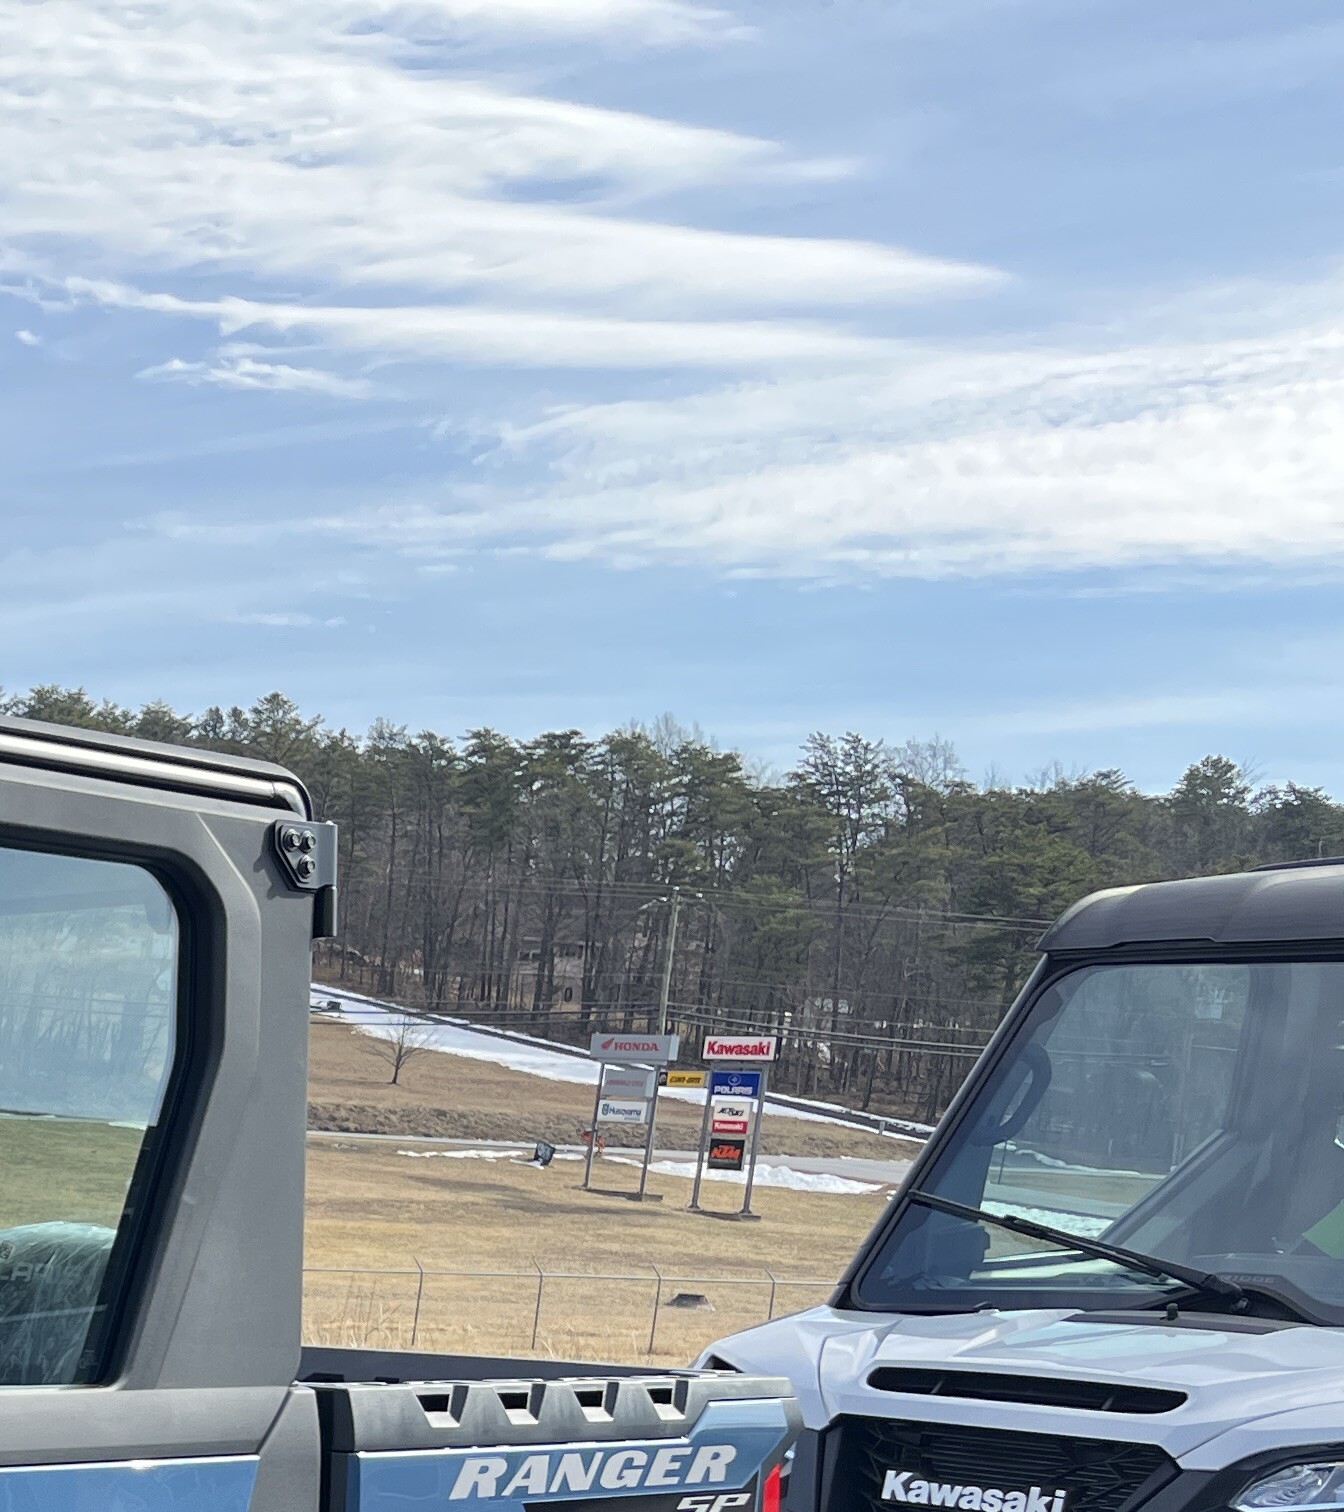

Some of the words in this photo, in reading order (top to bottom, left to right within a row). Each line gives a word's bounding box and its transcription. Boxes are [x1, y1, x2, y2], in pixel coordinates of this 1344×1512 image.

[614, 1042, 659, 1051] HONDA
[706, 1041, 771, 1056] Kawasaki
[714, 1086, 752, 1095] POLARIS
[711, 1145, 741, 1159] KTM
[448, 1444, 738, 1501] RANGER
